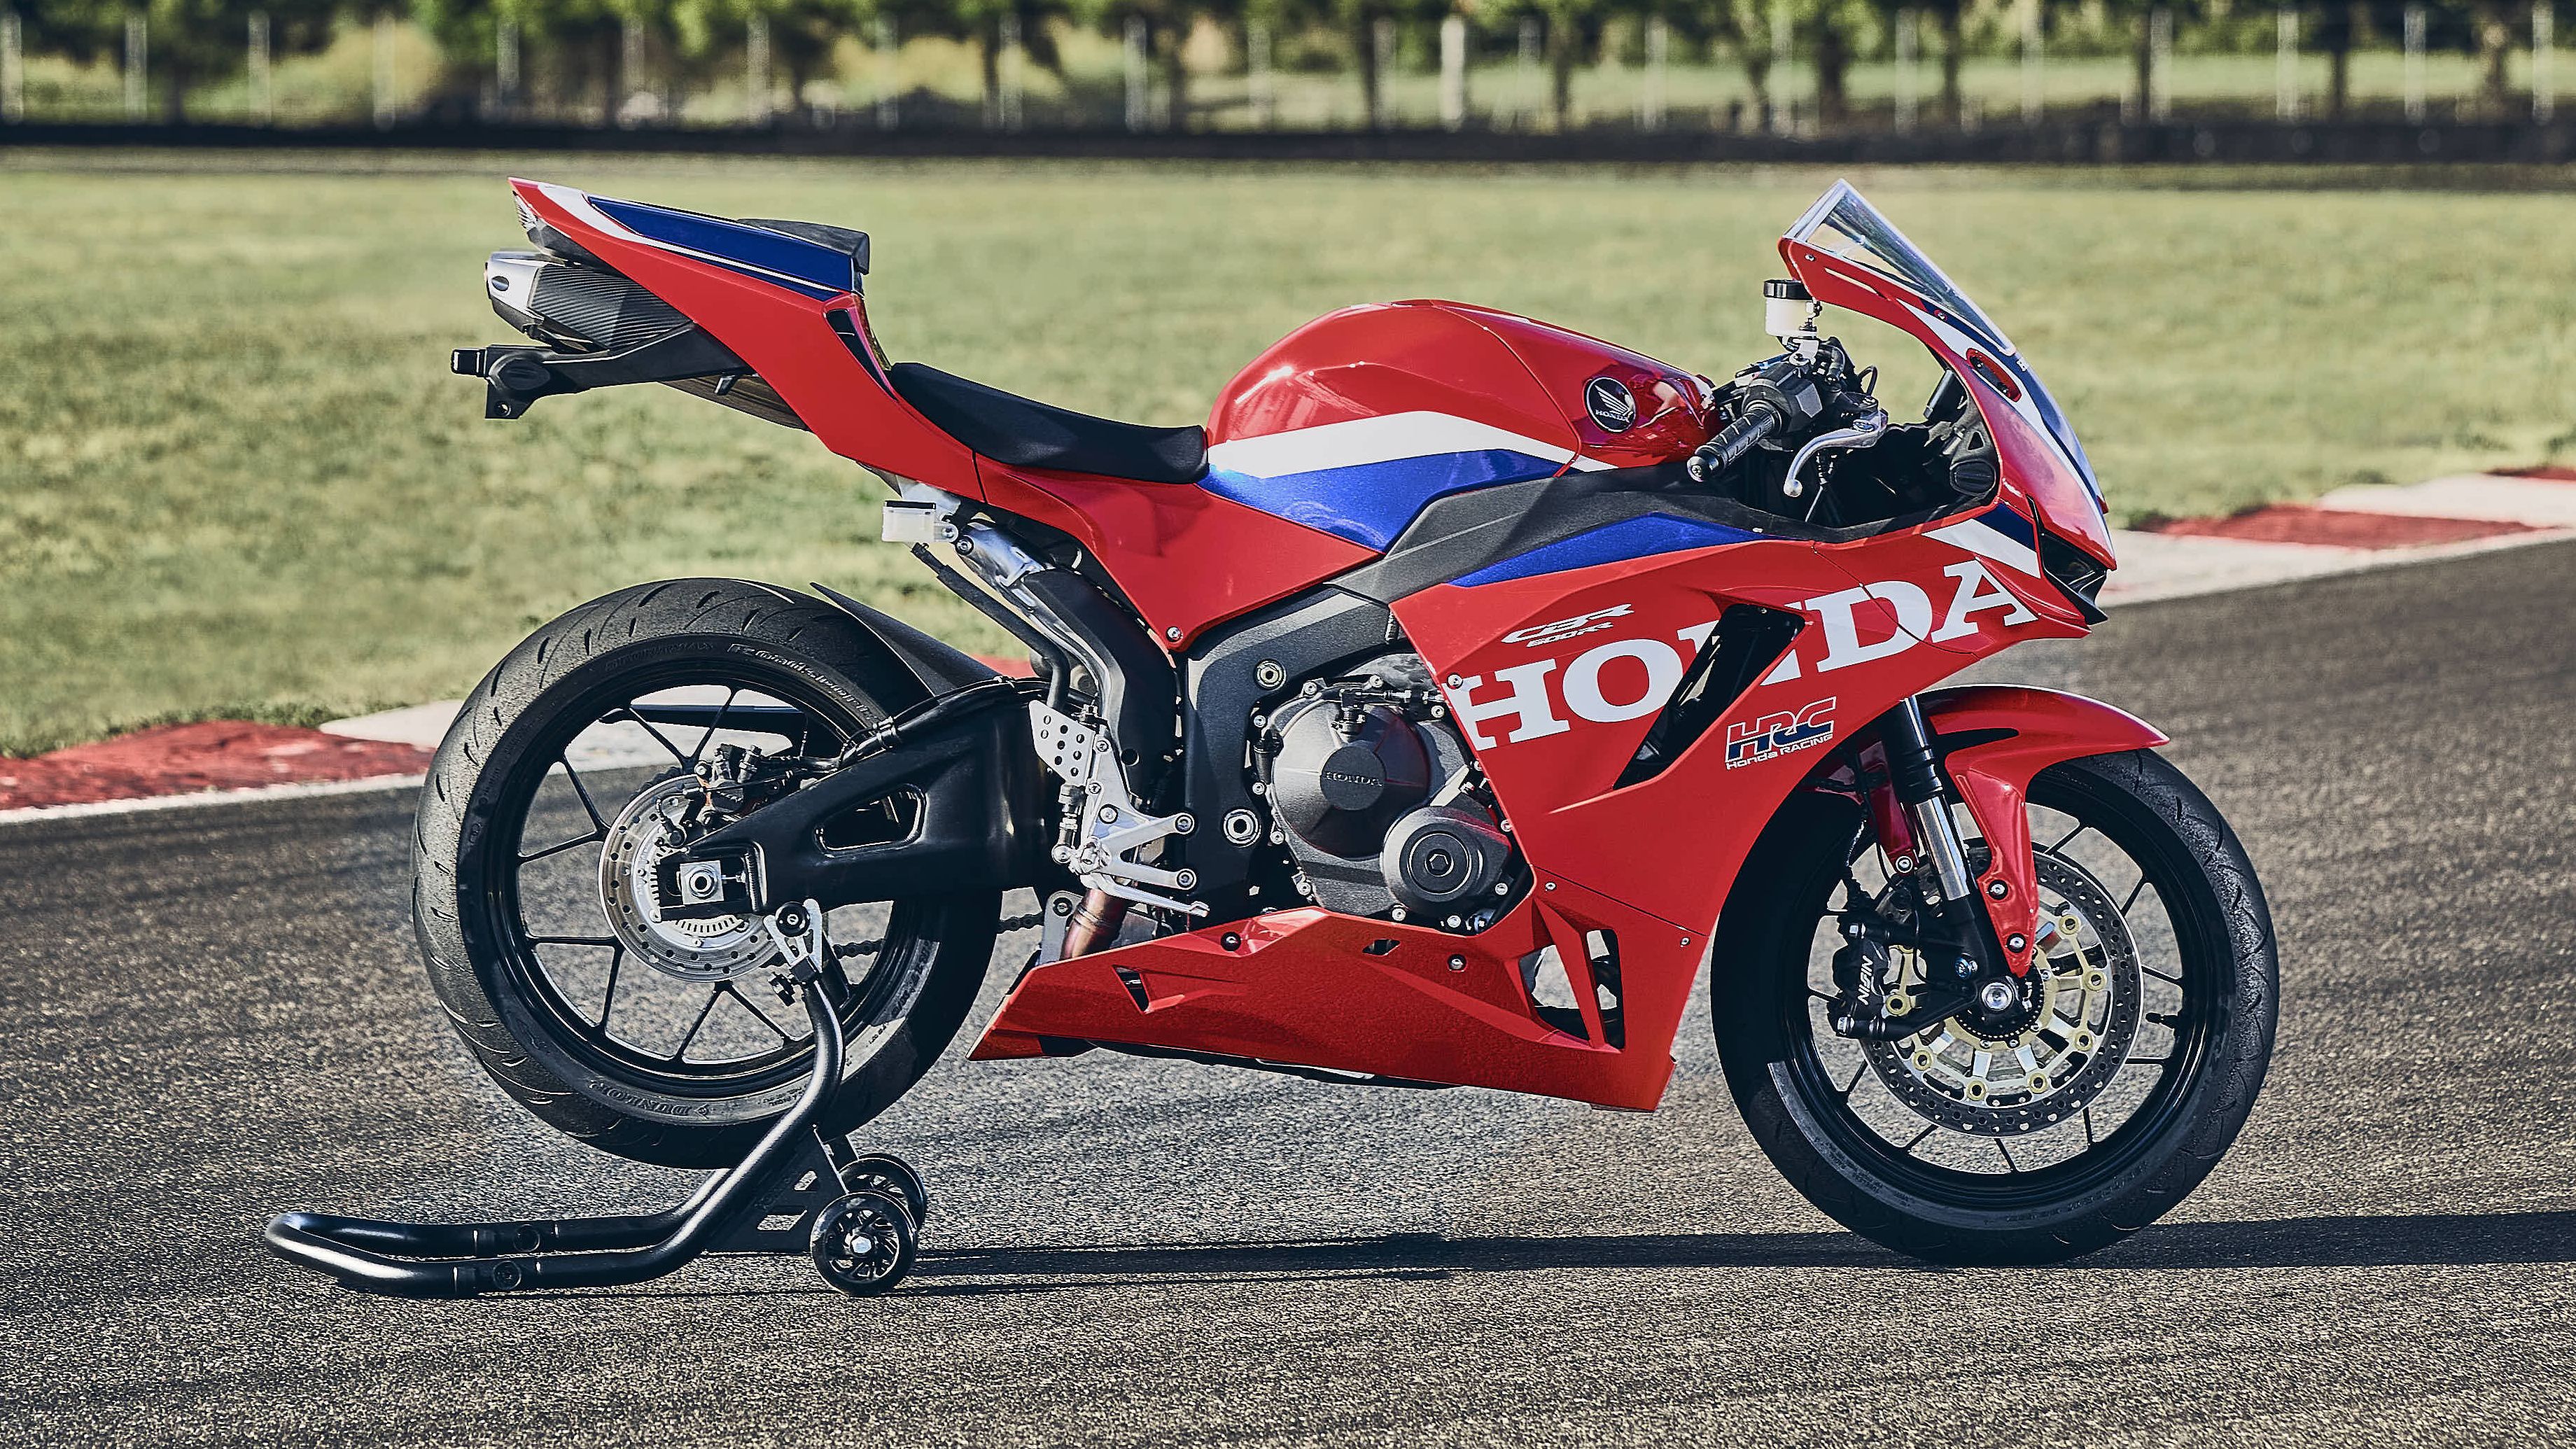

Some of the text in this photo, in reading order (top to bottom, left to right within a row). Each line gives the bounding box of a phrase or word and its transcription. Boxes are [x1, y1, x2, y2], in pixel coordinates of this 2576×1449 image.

[1595, 409, 1630, 424] HONDA
[1501, 603, 1634, 643] CBR
[1441, 556, 2039, 752] HODA
[1725, 696, 1837, 763] HRC
[1726, 733, 1833, 770] Honda RACING
[1326, 771, 1383, 787] HONDA
